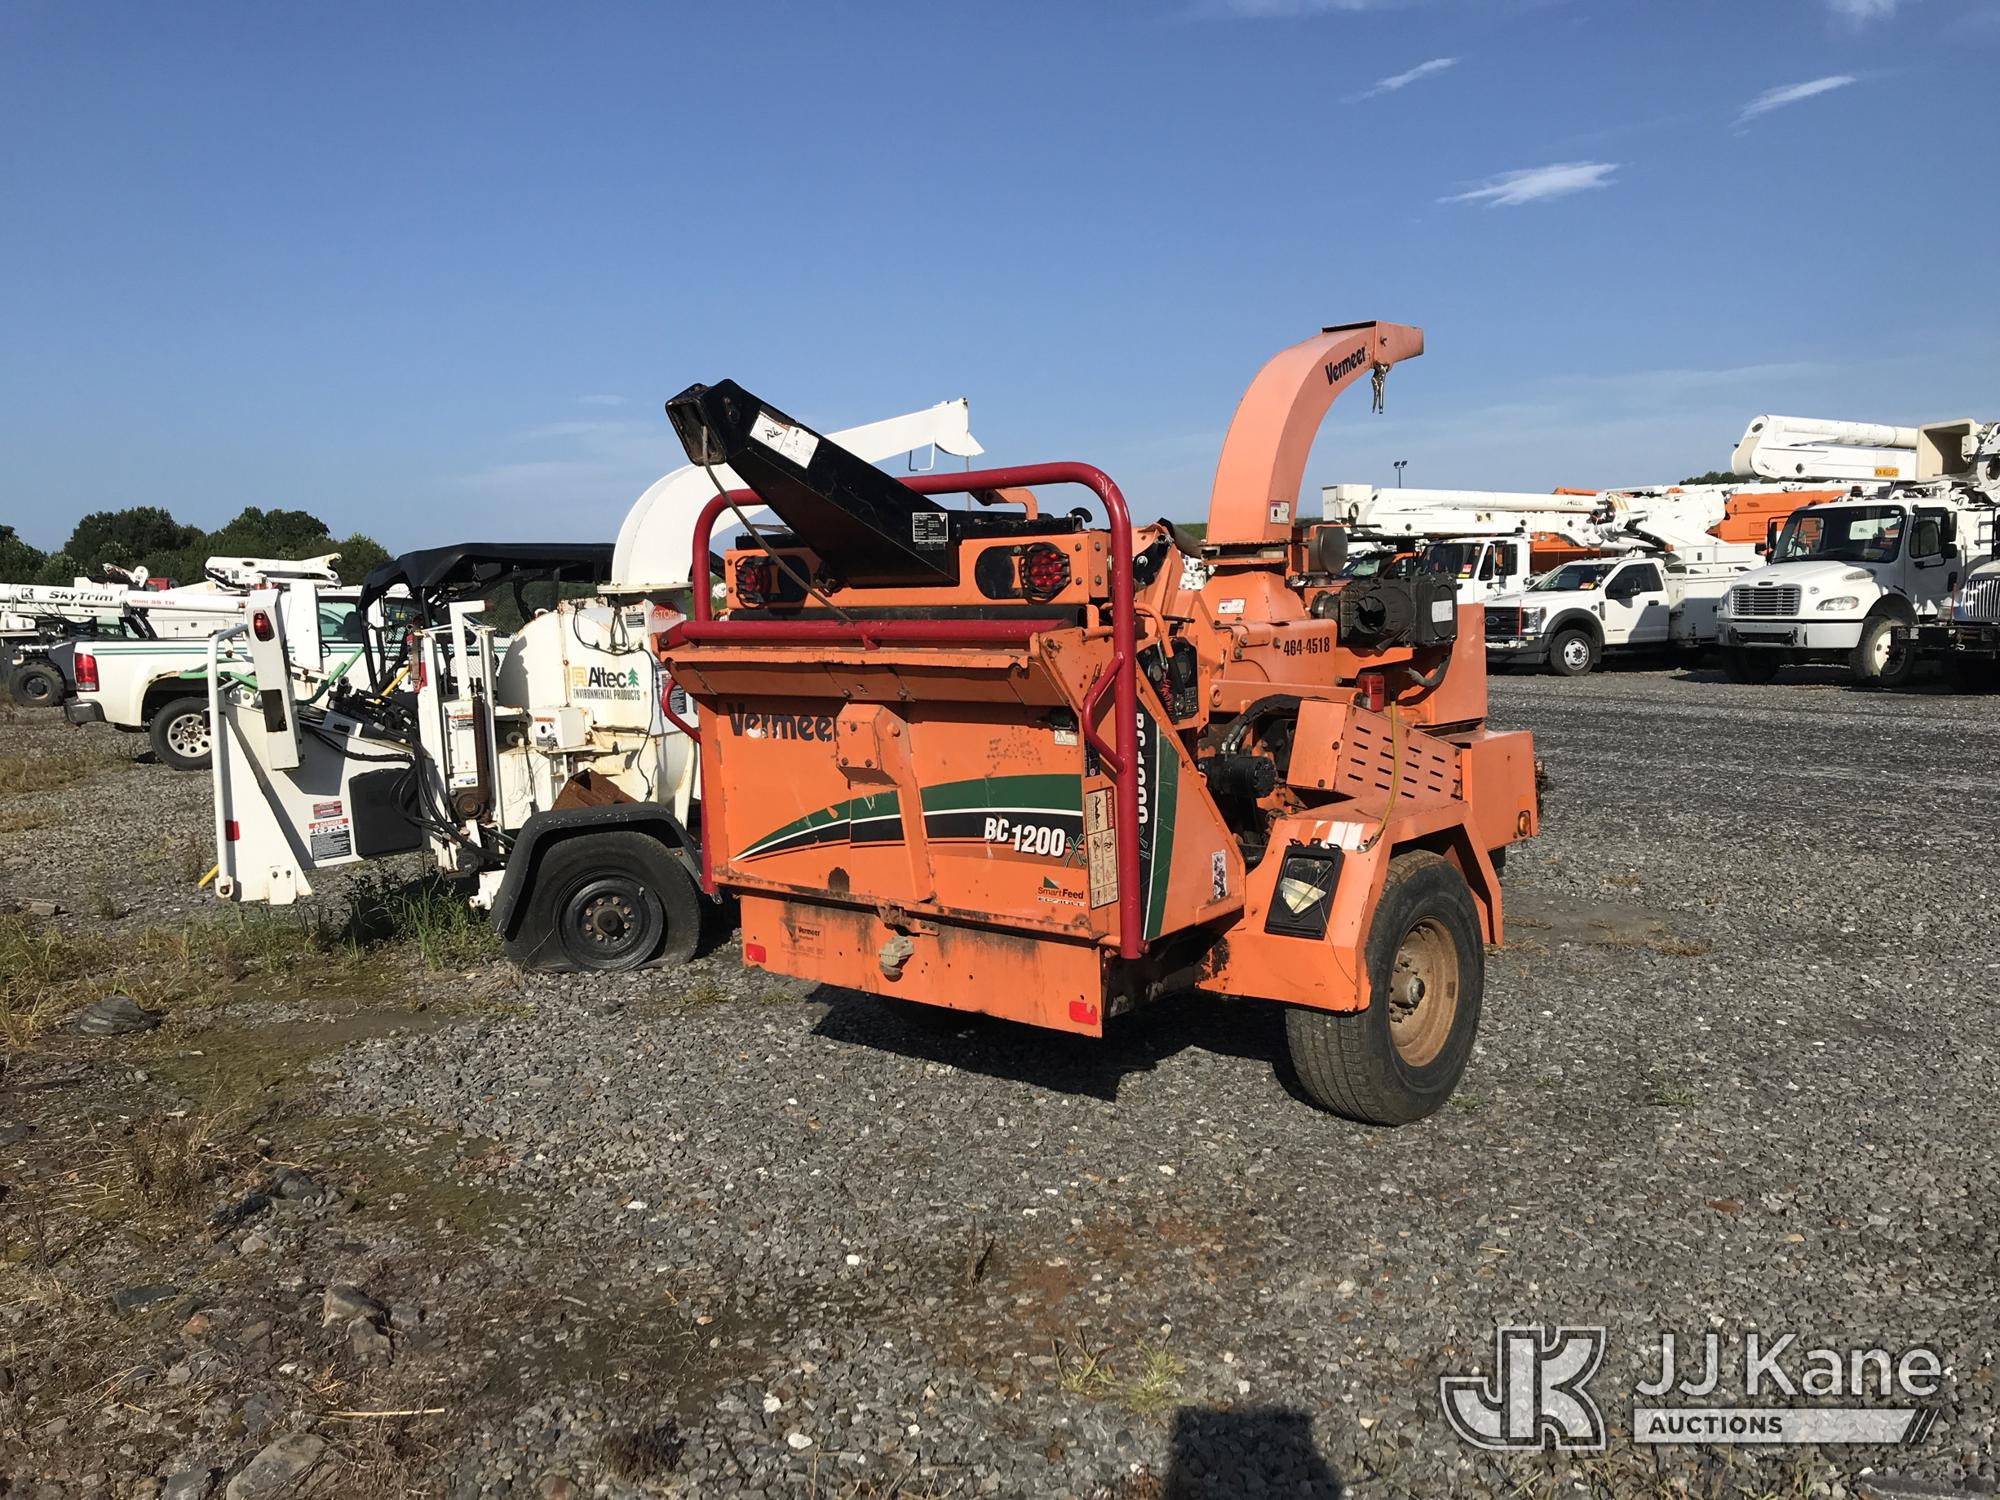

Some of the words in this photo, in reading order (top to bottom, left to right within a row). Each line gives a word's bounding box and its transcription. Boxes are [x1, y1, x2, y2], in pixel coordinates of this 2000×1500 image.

[1325, 346, 1366, 385] Vermeer
[49, 590, 114, 602] SkyTrim
[1283, 636, 1331, 656] 464-4518
[588, 666, 628, 688] Altec
[573, 688, 613, 700] ENVIRONMENTAL
[613, 690, 641, 700] PRODUCTS
[984, 817, 1010, 842] BC
